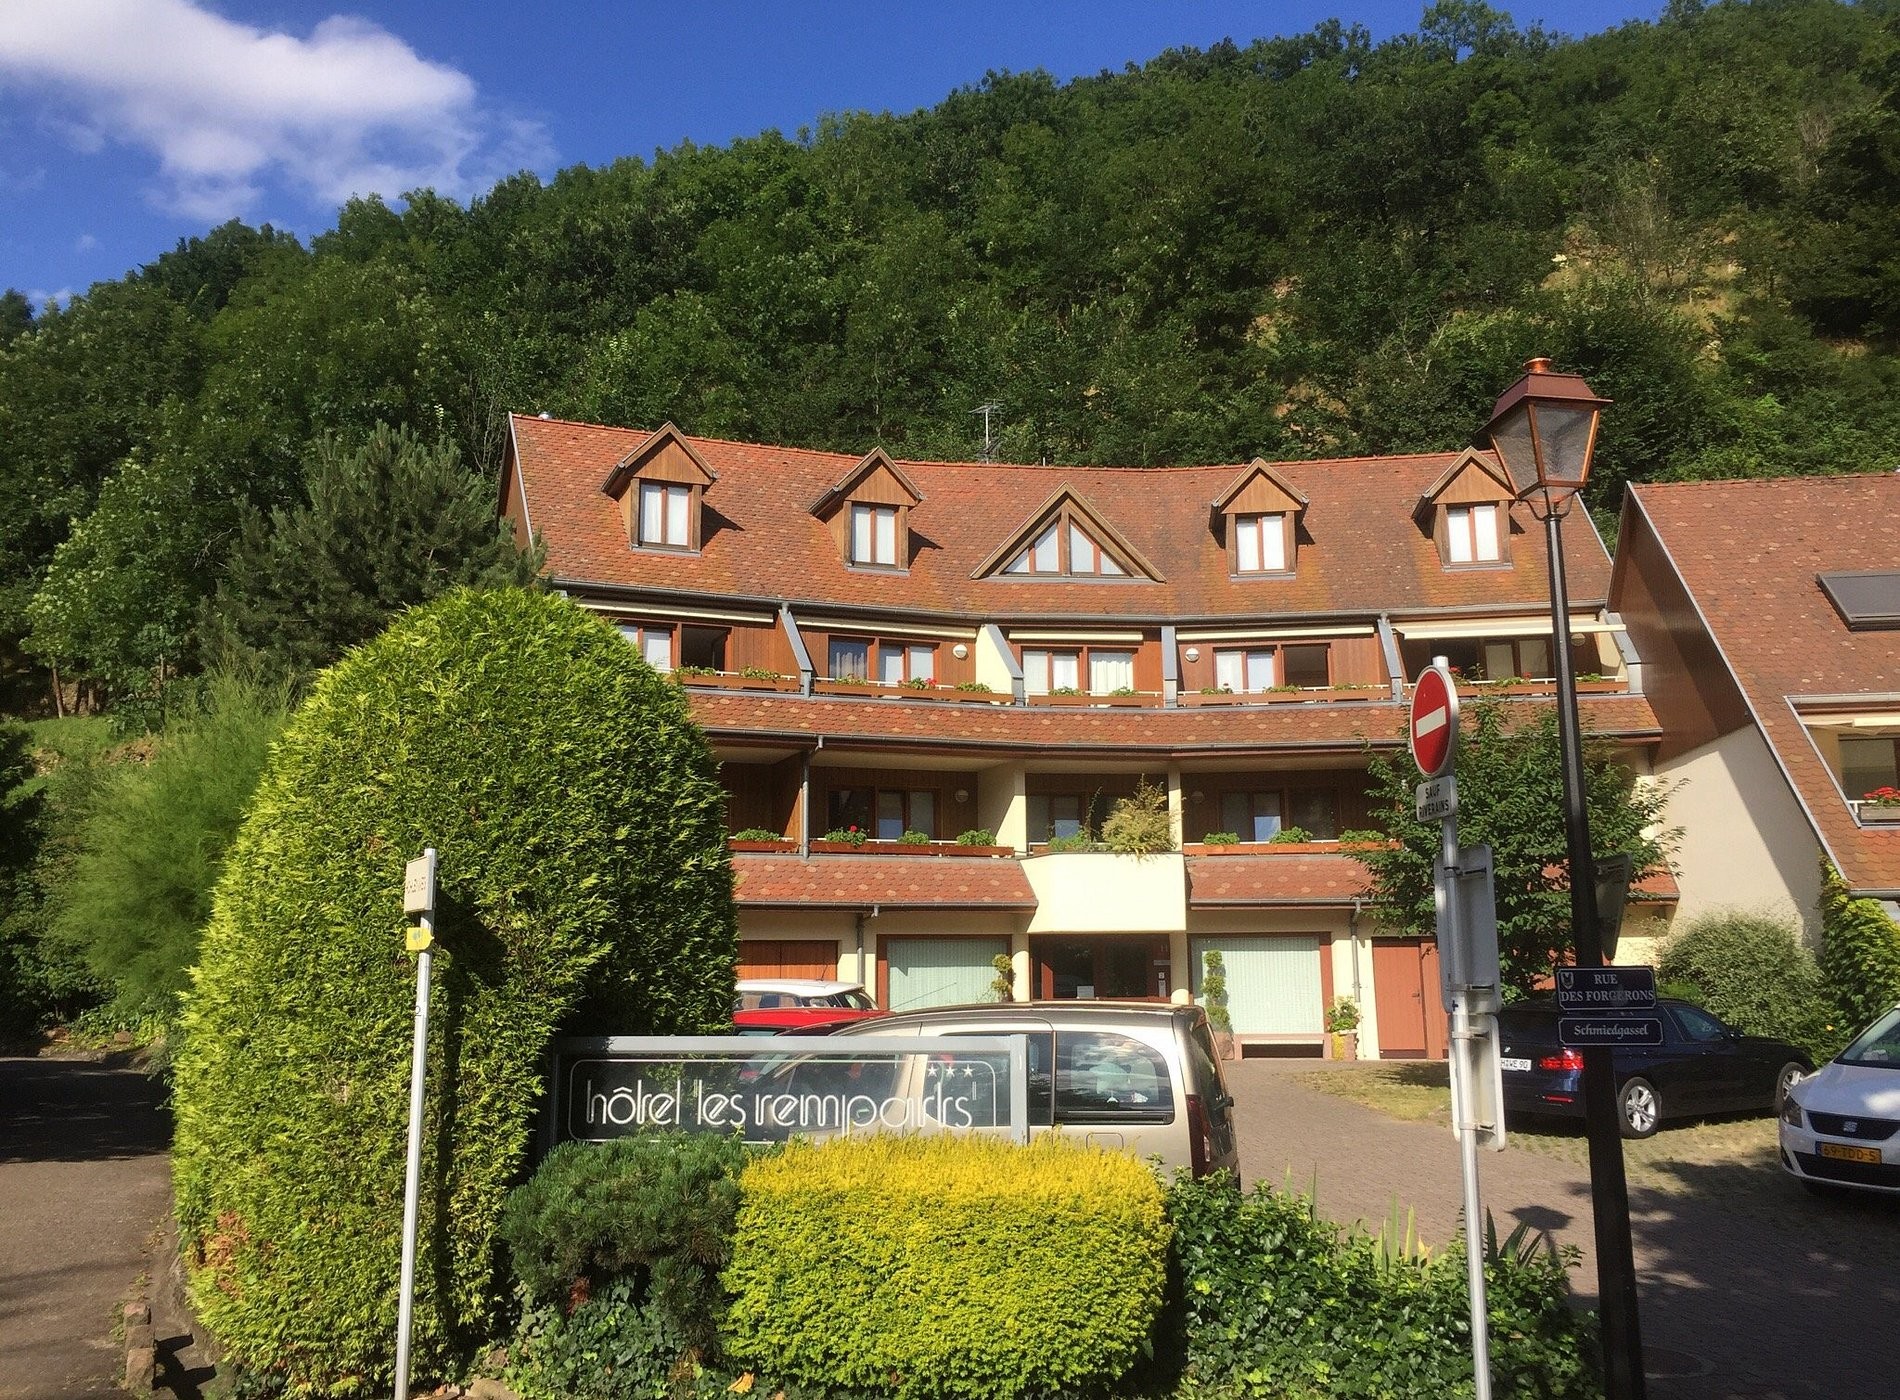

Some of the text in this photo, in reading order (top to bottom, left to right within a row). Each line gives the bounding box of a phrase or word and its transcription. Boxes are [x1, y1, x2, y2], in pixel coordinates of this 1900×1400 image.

[1425, 783, 1441, 799] SAUF
[1594, 974, 1618, 985] RUE
[1560, 989, 1654, 1002] DES FORGERONS
[1574, 1023, 1649, 1040] Schmiedgassel
[586, 1079, 681, 1125] hôtel
